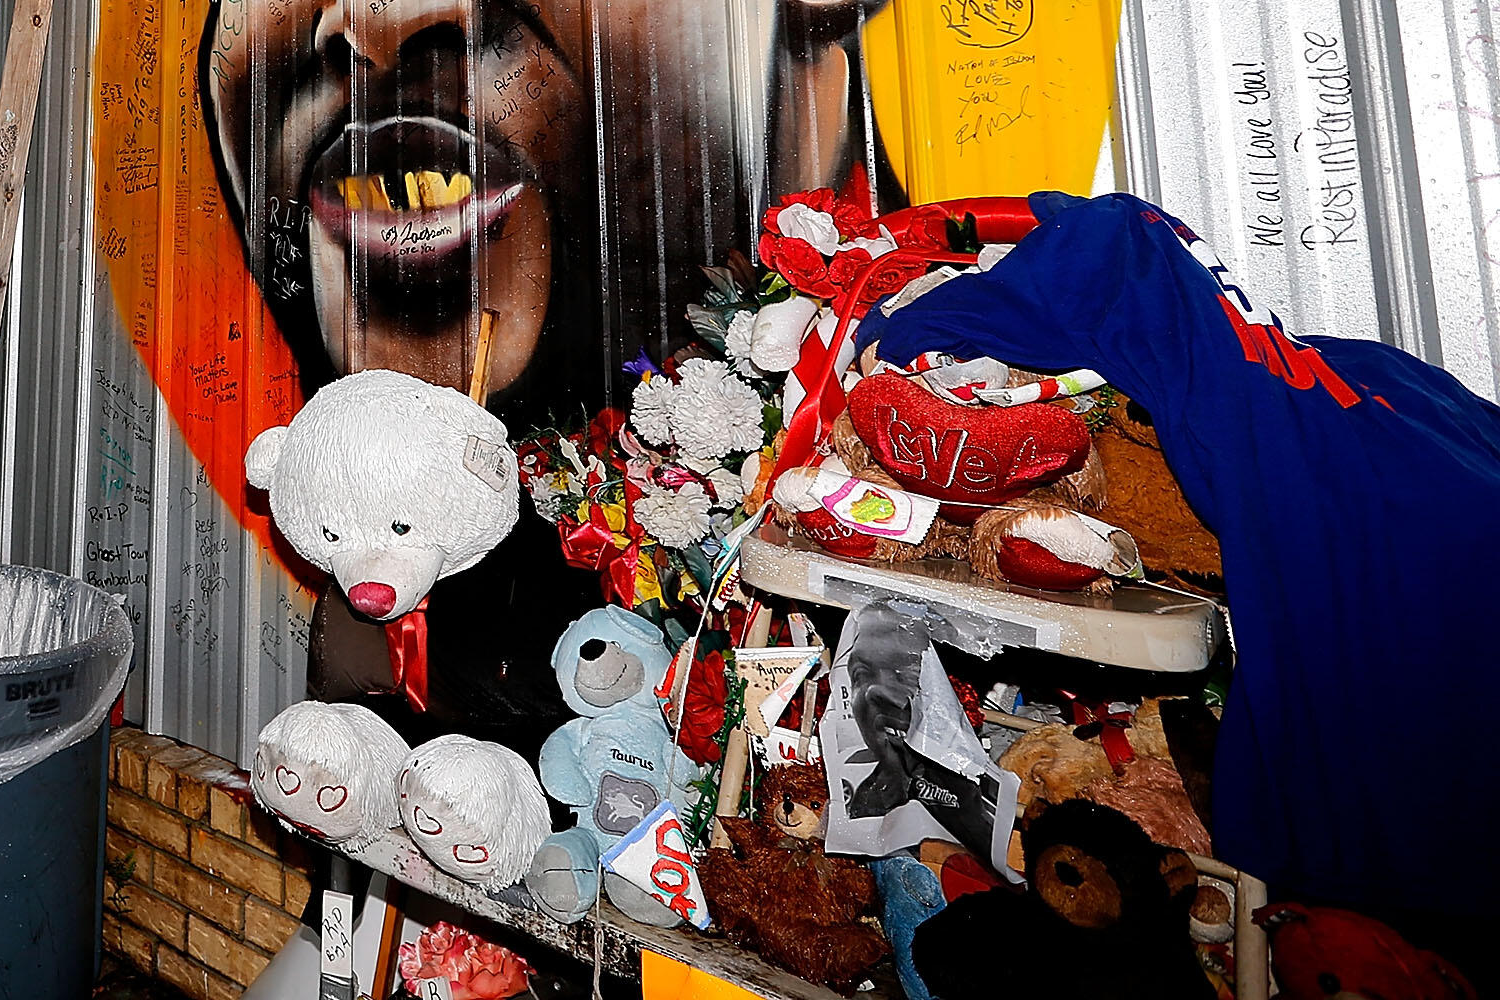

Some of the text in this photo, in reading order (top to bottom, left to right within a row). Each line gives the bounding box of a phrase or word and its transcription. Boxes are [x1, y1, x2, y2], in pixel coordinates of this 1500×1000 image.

[1294, 31, 1357, 153] Paradise
[1249, 171, 1280, 202] all
[1248, 214, 1284, 246] We
[1300, 180, 1358, 251] Rest
[195, 367, 229, 388] Matters
[610, 748, 655, 772] Taurus
[916, 778, 959, 806] Miller
